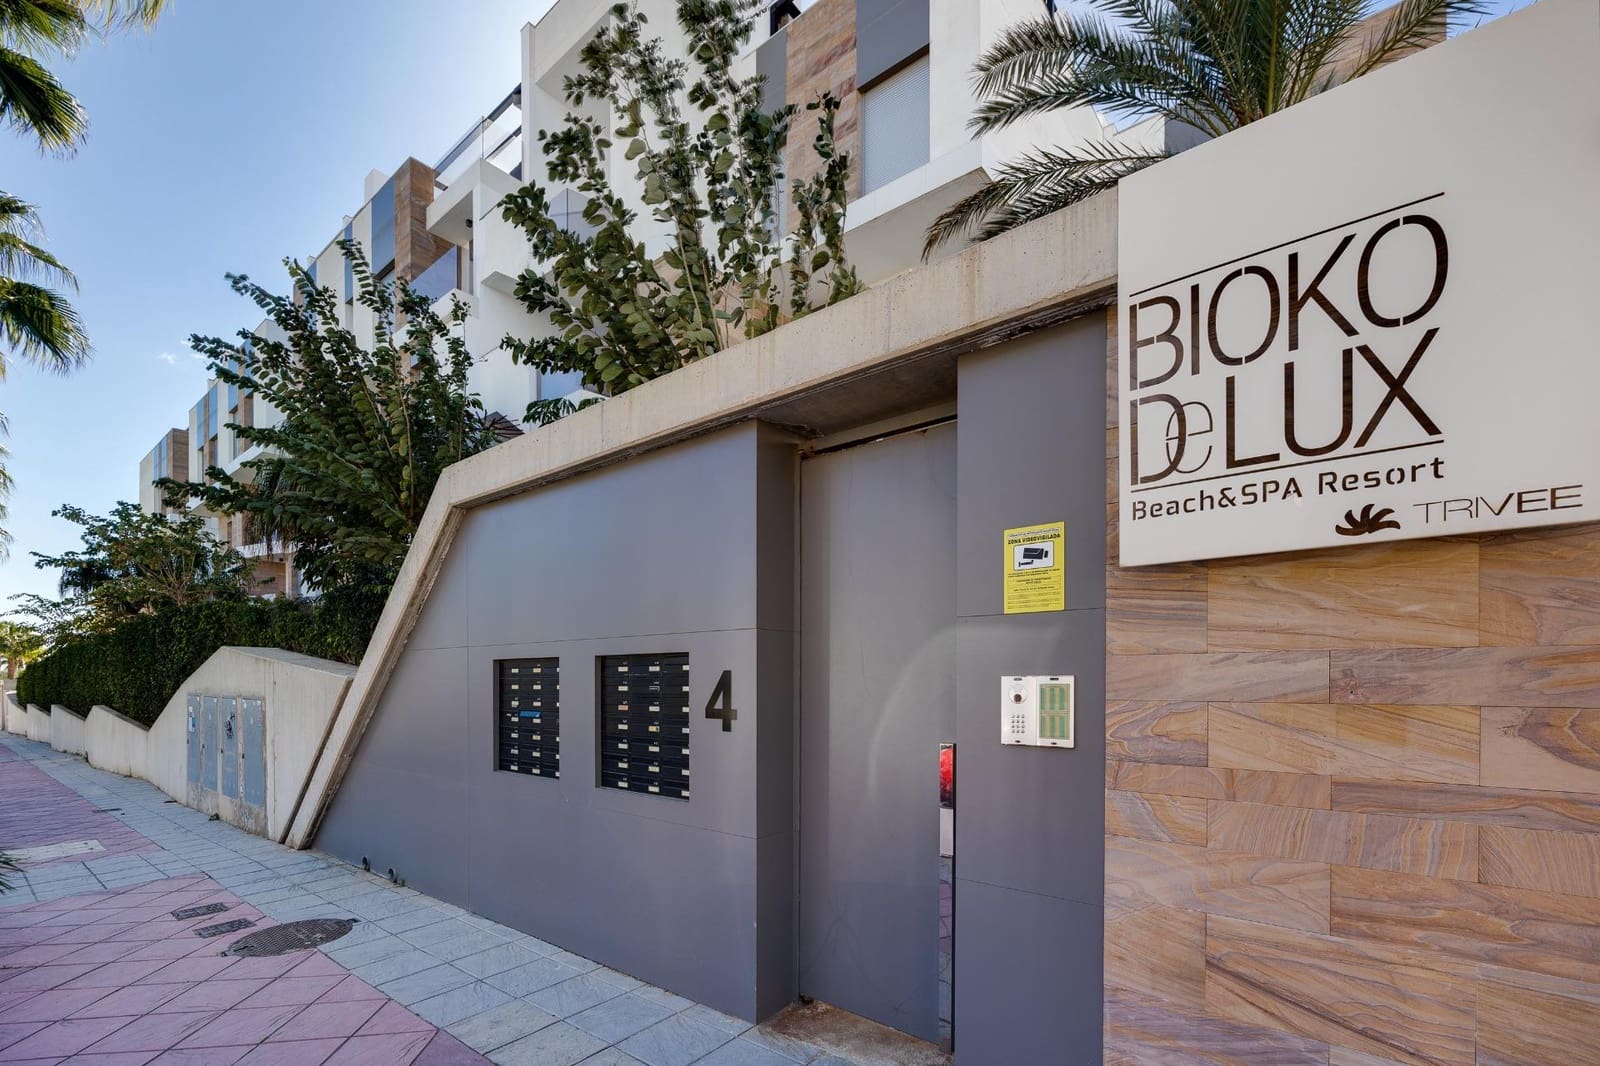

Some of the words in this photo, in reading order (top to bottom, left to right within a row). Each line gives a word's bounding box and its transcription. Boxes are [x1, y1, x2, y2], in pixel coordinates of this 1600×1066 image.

[1129, 214, 1449, 391] BIOKO
[1318, 457, 1445, 495] Resort
[1412, 485, 1583, 523] TRIVEE
[705, 670, 737, 732] 4
